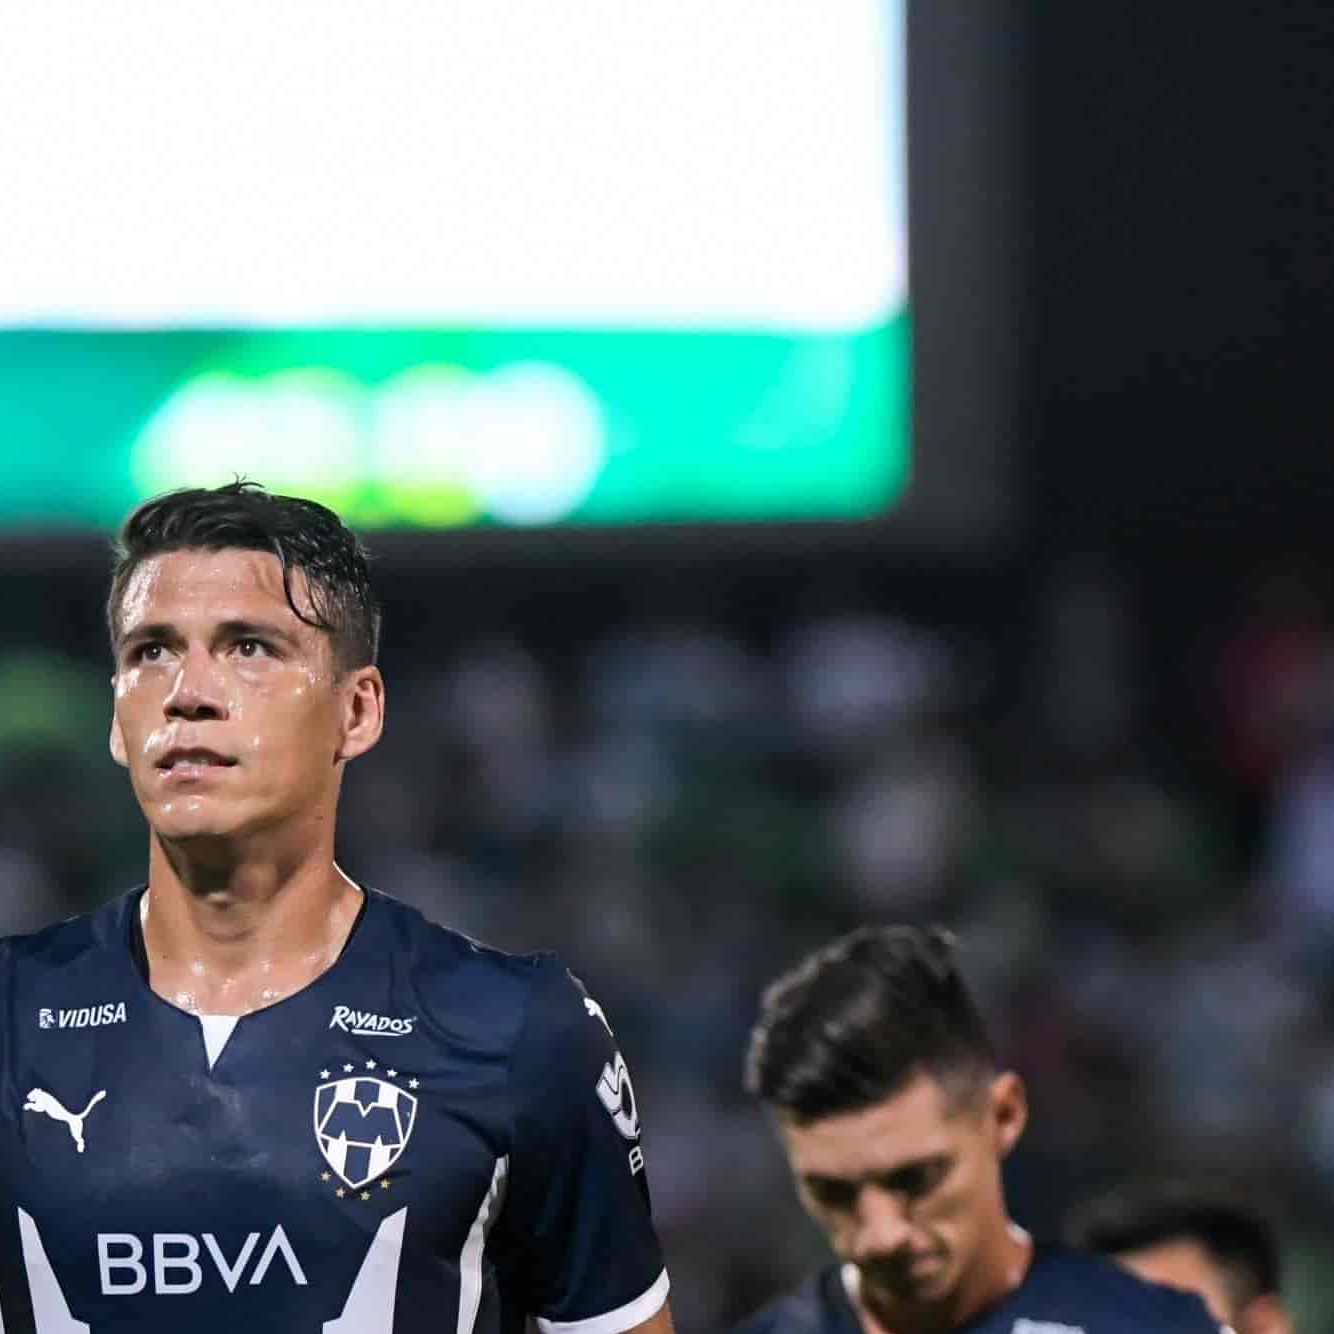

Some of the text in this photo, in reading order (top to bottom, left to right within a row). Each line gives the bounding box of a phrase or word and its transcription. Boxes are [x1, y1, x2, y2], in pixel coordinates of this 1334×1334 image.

[58, 1001, 127, 1029] VIDUSA
[328, 1005, 413, 1036] RAYADOS
[96, 1223, 309, 1296] BBVA
